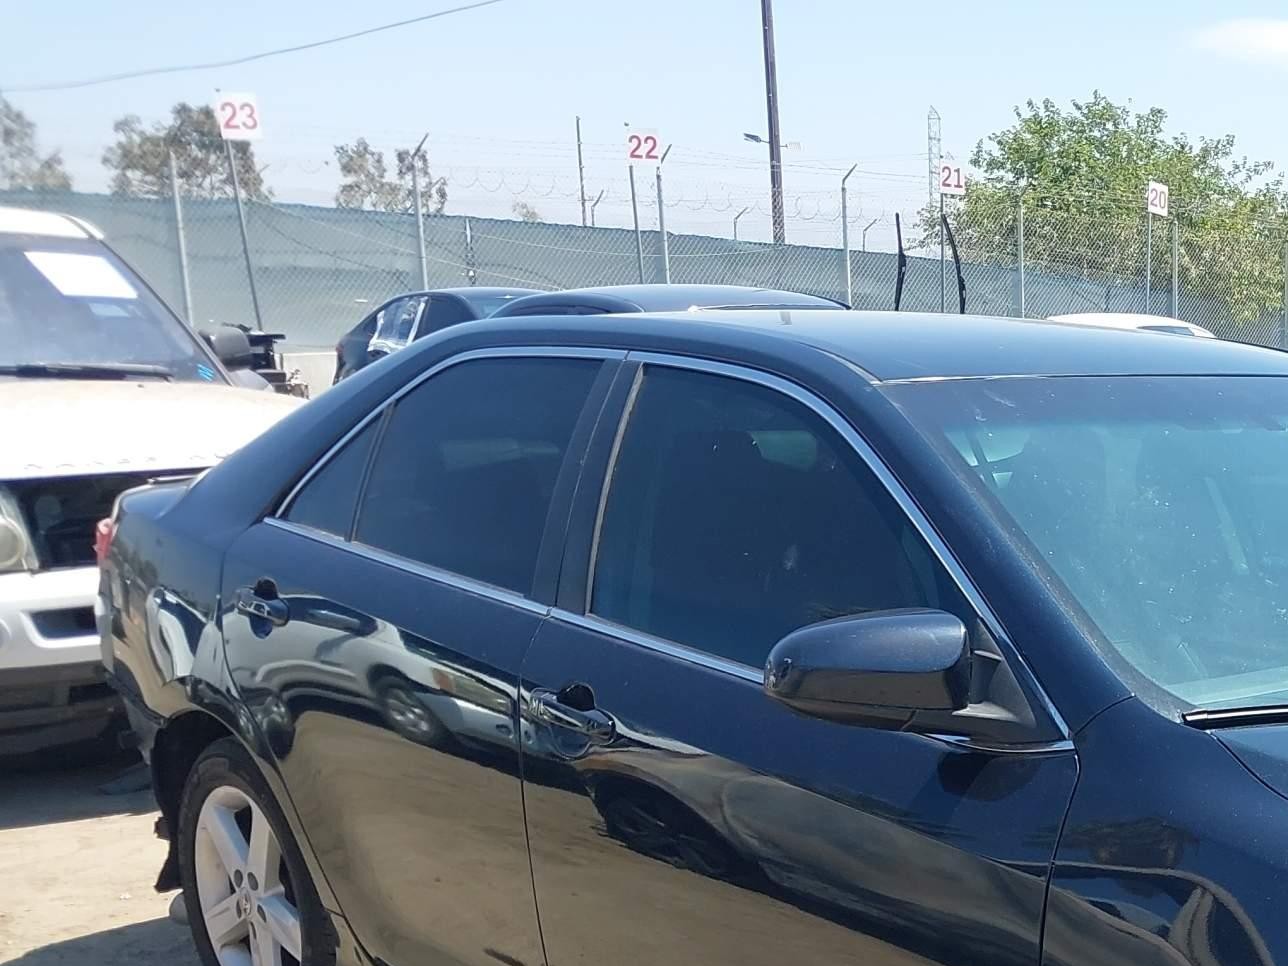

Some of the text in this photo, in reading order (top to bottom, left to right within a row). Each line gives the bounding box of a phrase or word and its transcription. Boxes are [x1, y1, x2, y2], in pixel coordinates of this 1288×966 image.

[220, 101, 258, 130] 23
[628, 134, 659, 160] 22
[941, 165, 963, 189] 21
[1150, 187, 1167, 209] 20
